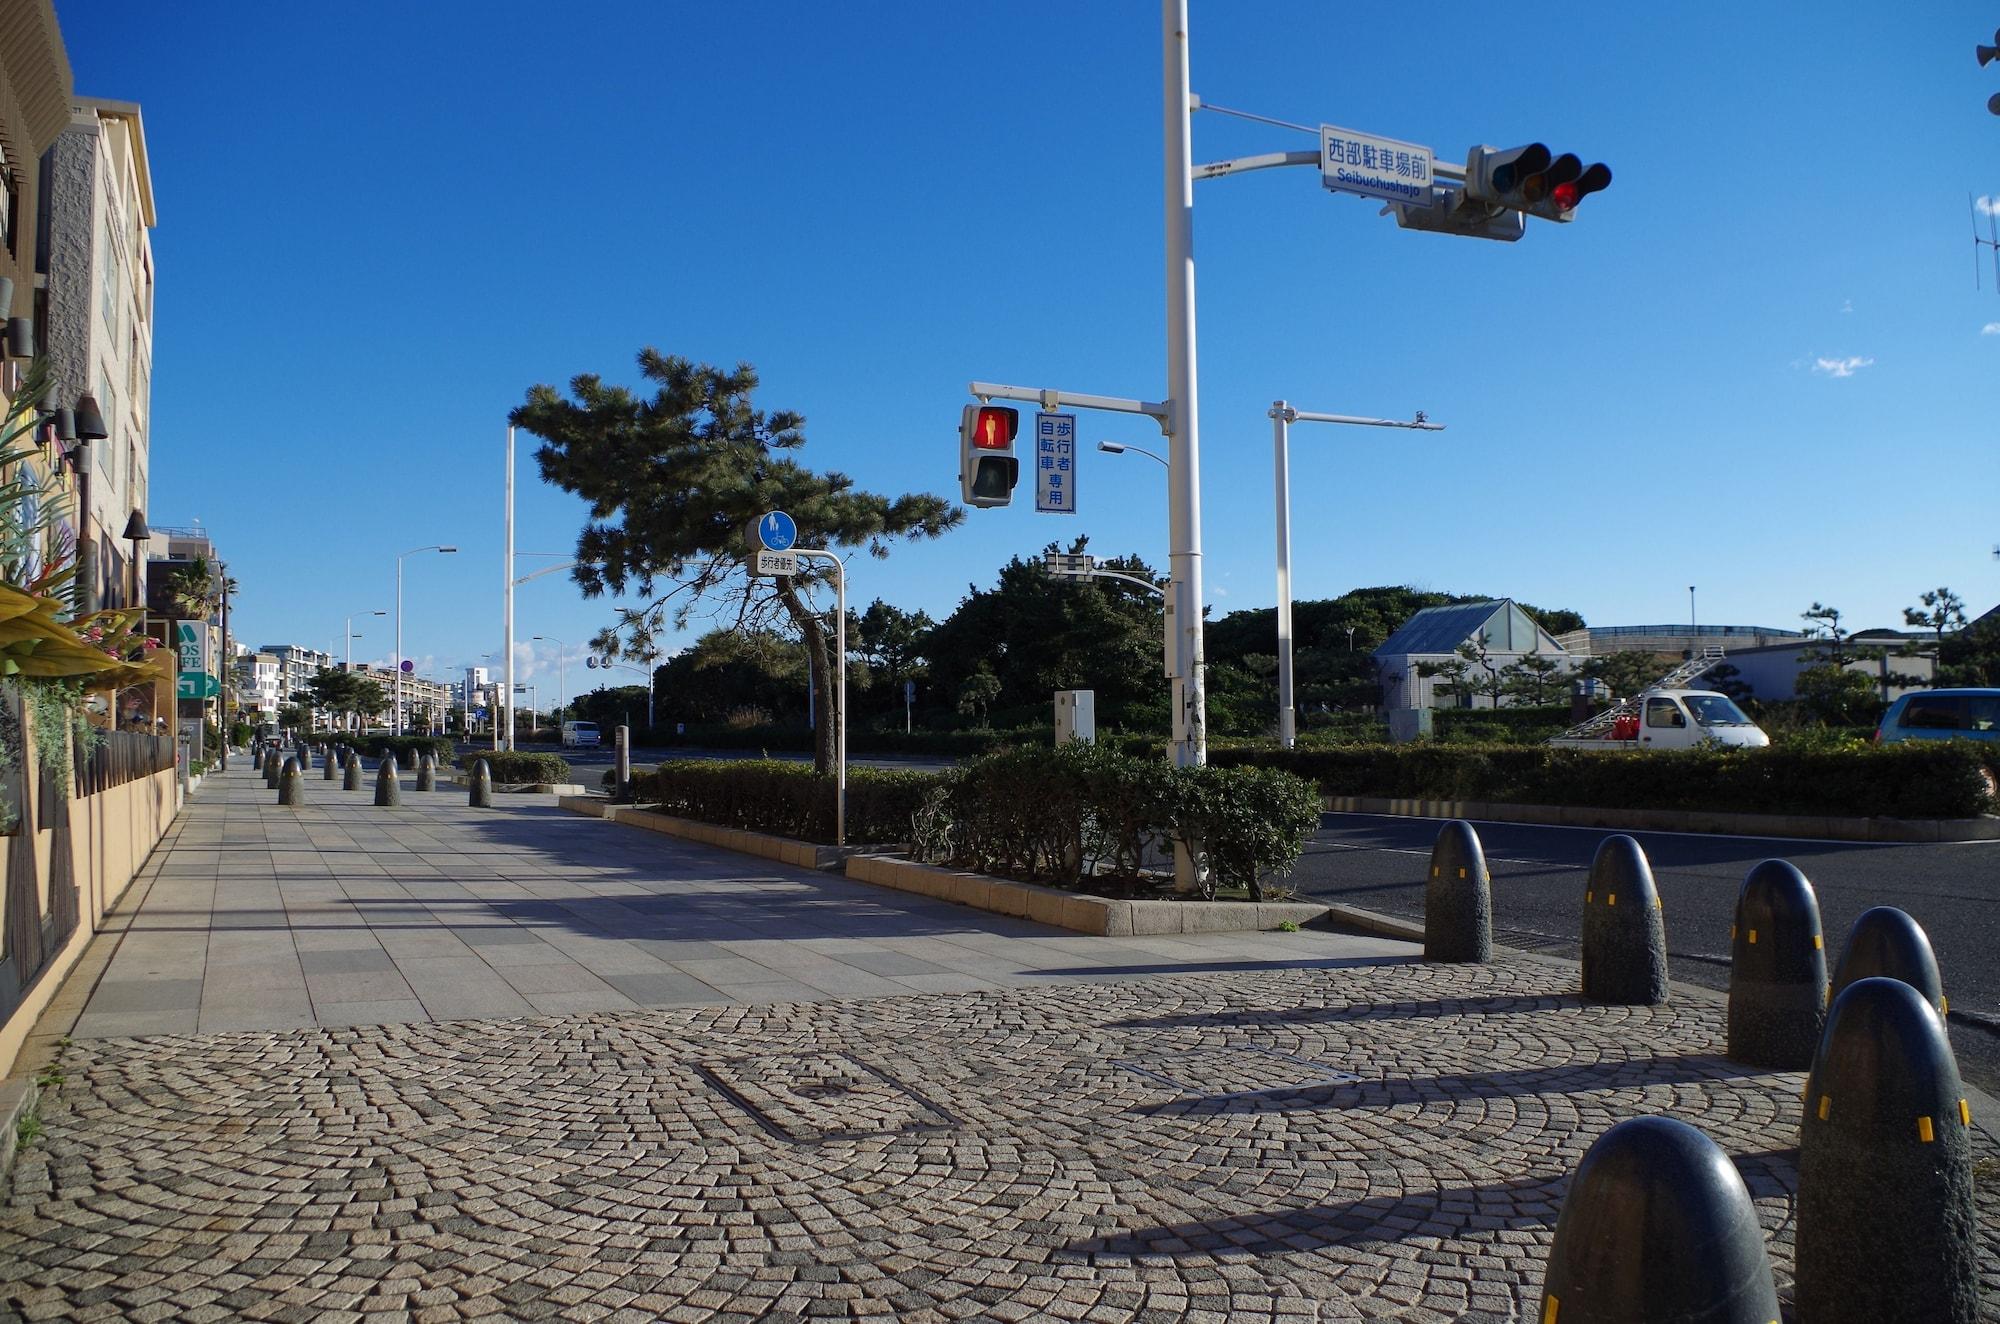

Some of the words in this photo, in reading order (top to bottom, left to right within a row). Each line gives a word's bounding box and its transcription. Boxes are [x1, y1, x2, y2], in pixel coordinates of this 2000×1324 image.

[1328, 137, 1427, 180] 西部駐車場前
[1337, 168, 1420, 198] Seibuchushajo
[1040, 421, 1054, 471] 自転車
[1057, 422, 1071, 471] 歩行者
[1049, 474, 1063, 504] 専用
[180, 645, 199, 656] OS
[182, 656, 201, 668] FE
